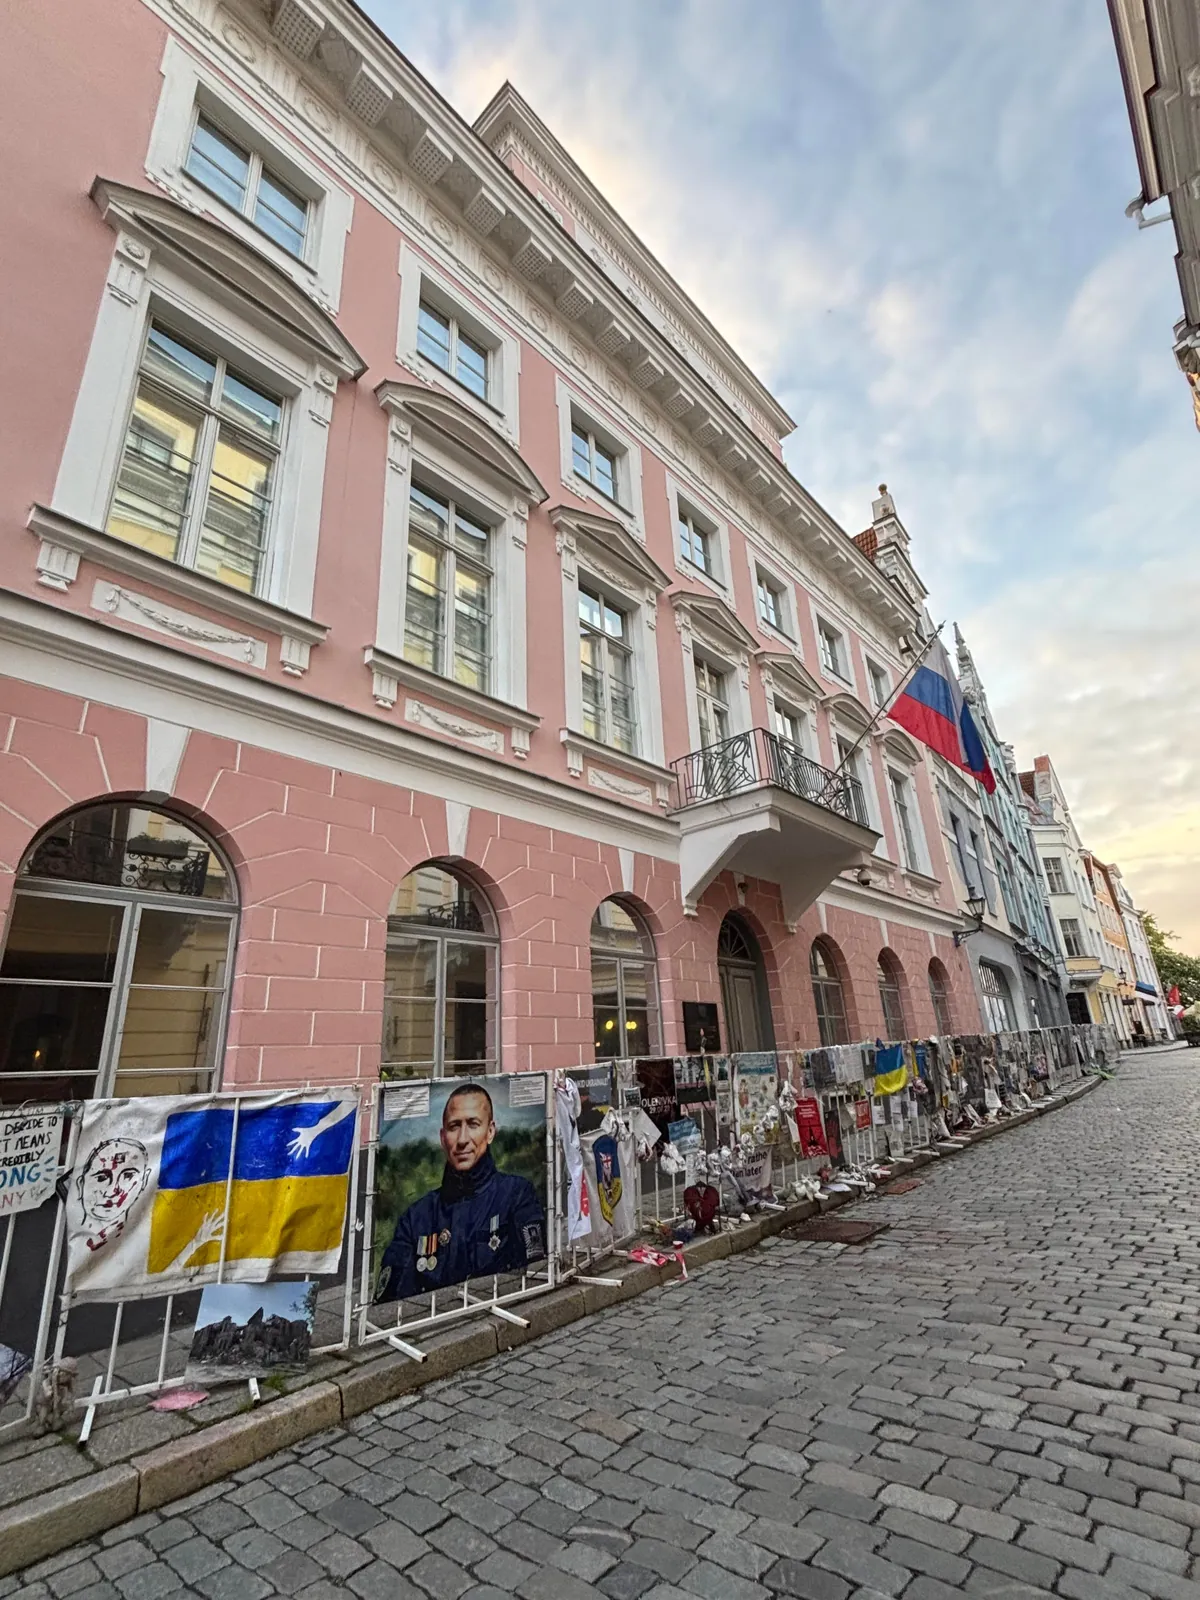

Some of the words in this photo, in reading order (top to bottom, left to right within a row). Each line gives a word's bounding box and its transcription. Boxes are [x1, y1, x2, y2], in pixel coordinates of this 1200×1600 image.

[47, 1115, 58, 1127] TO
[15, 1132, 52, 1150] MEANS
[744, 1165, 763, 1177] later
[0, 1190, 26, 1209] NY
